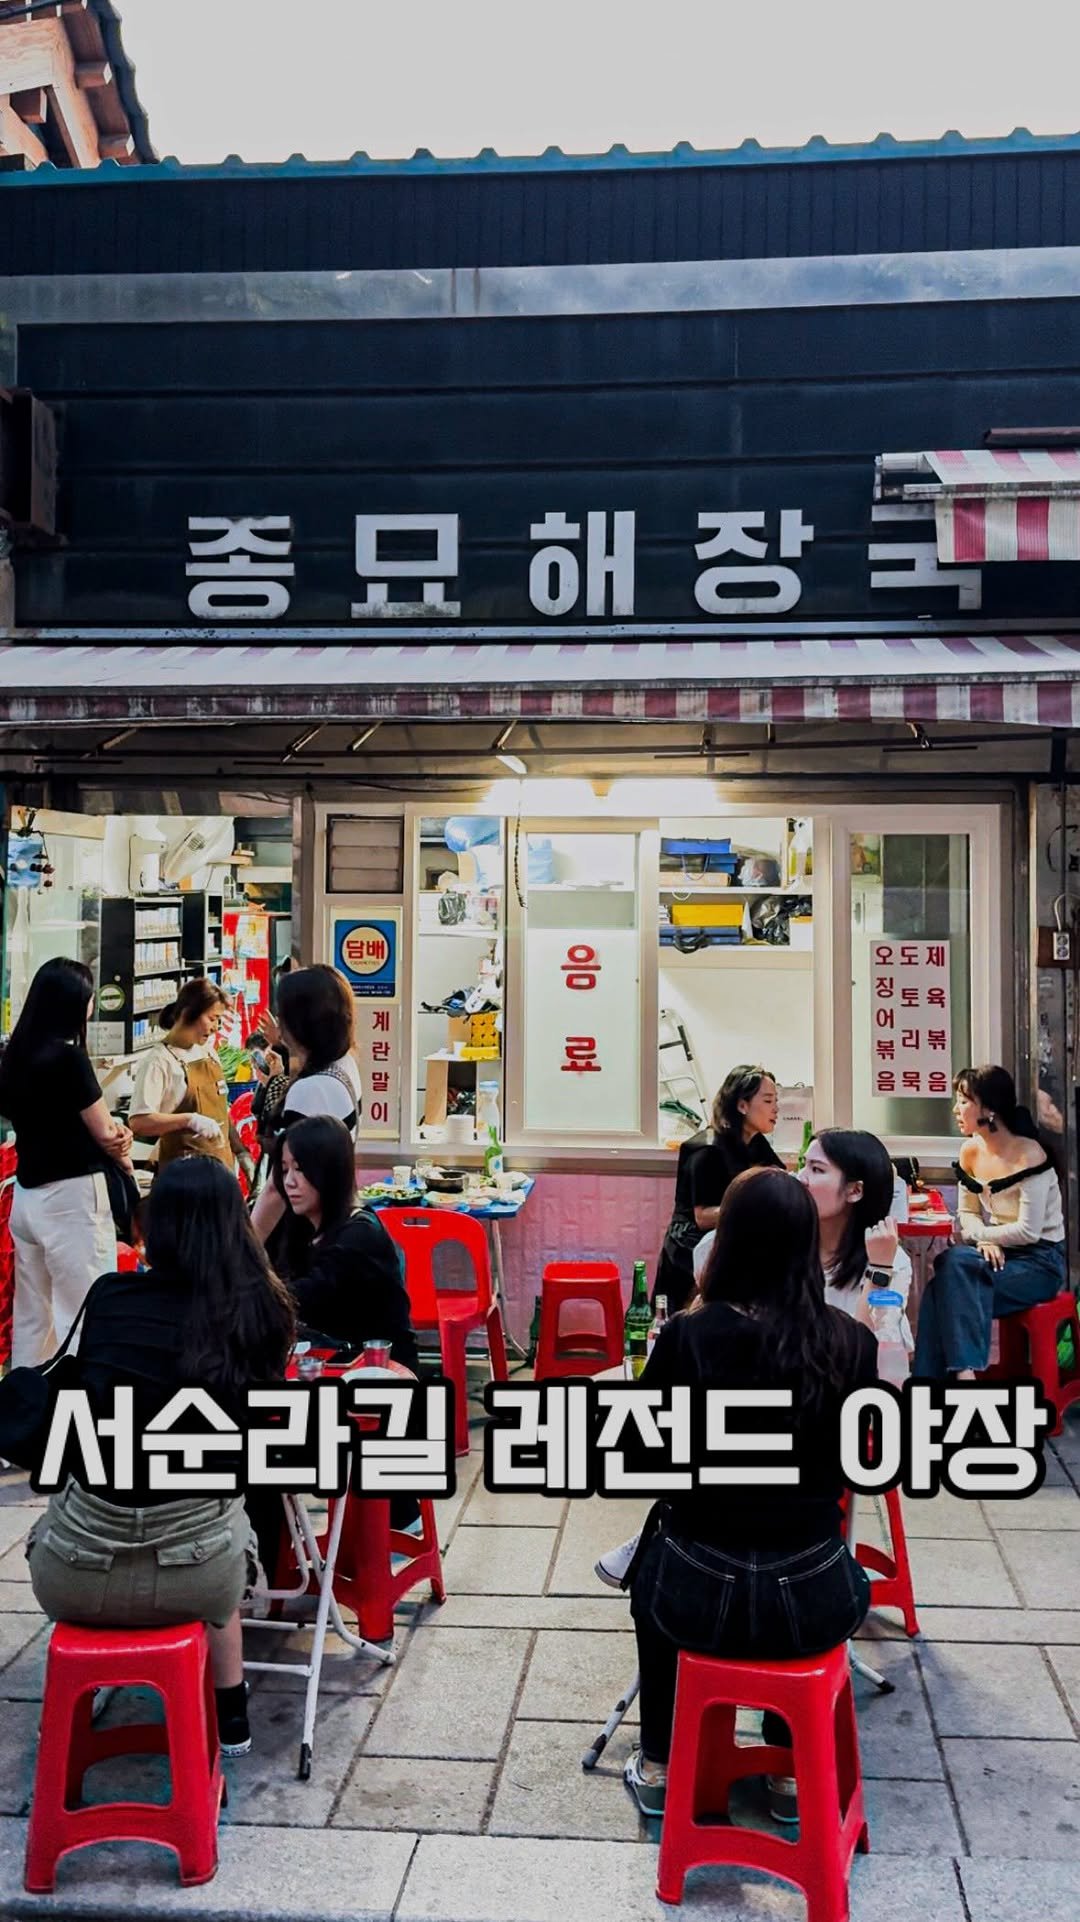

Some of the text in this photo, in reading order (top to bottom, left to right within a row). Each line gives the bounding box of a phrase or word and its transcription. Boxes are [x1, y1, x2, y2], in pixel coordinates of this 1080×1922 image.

[185, 509, 983, 619] 종묘해장국
[346, 939, 385, 960] 담배
[560, 944, 602, 1073] 음료
[370, 1010, 392, 1123] 계란말이
[875, 946, 896, 1093] 오징어볶음
[899, 946, 921, 1090] 도토리묵
[925, 945, 947, 1093] 제육볶음
